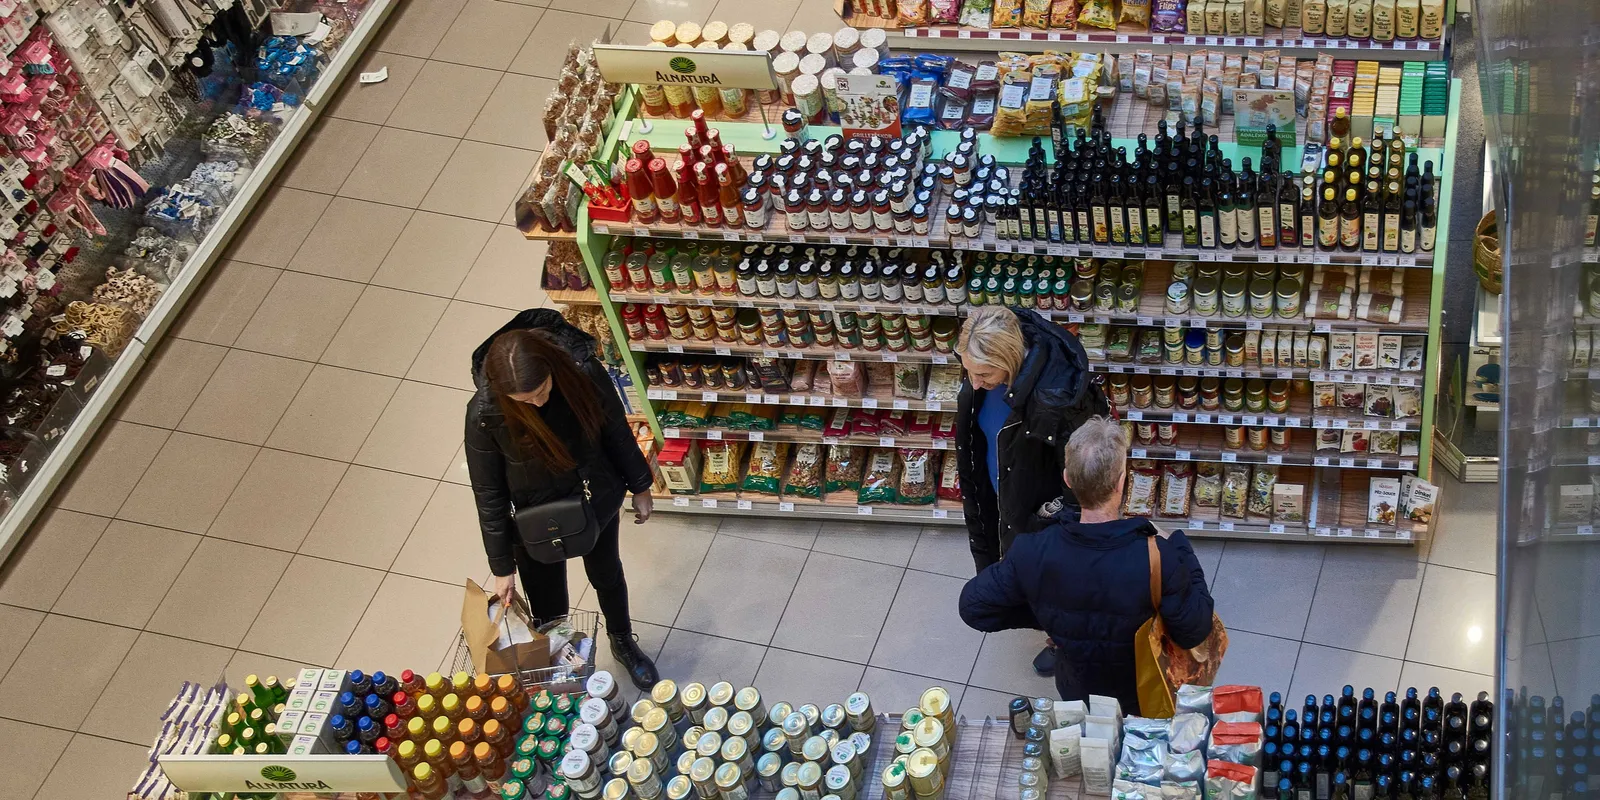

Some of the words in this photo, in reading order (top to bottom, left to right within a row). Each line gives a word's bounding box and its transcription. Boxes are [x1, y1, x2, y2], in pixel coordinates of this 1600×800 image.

[1159, 2, 1176, 11] Flips
[655, 71, 722, 85] ALNATURA
[1415, 489, 1432, 498] Dinkel
[245, 780, 333, 790] ALNATURA
